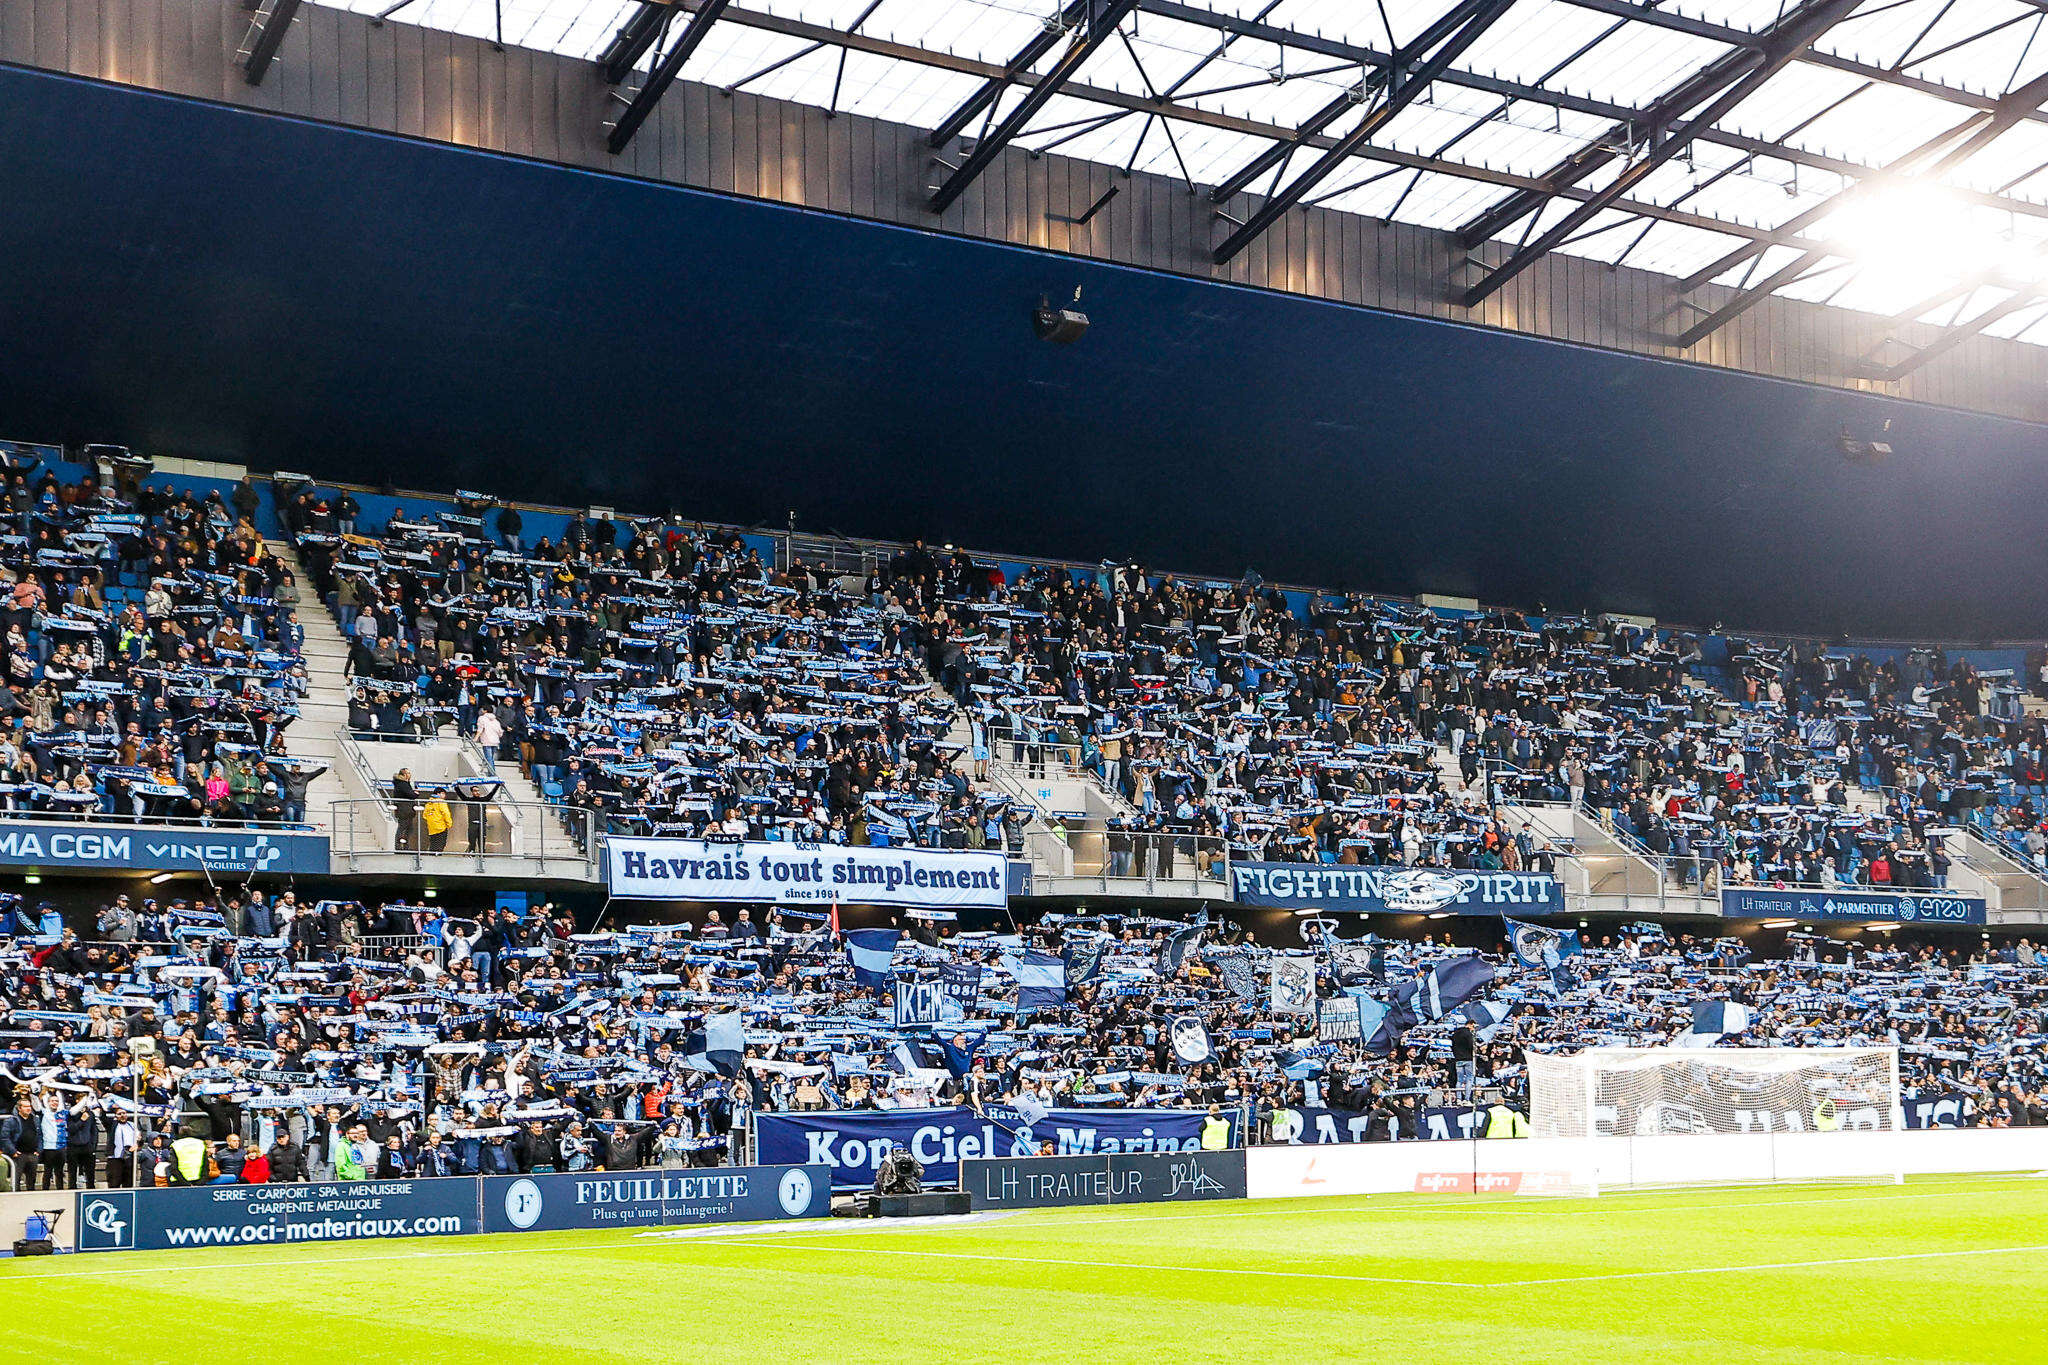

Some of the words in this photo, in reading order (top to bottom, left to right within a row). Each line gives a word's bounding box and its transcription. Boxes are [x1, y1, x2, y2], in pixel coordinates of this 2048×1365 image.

[144, 784, 167, 794] HAC
[50, 834, 130, 861] CGM
[146, 844, 237, 860] VINCI
[622, 851, 750, 880] Havrais
[759, 856, 822, 882] tout
[832, 857, 1000, 891] simplement
[785, 889, 811, 899] since
[1233, 866, 1385, 898] FIGHTIN
[1456, 874, 1553, 903] PIRIT
[1741, 897, 1753, 910] LH
[1754, 900, 1792, 912] TRAITEUR
[1837, 901, 1895, 916] PARMENTIER
[901, 984, 943, 1022] KCM
[514, 1010, 542, 1021] HAC
[988, 1107, 1019, 1120] Havr
[911, 1124, 996, 1164] Ciel
[1056, 1127, 1201, 1155] Marine
[213, 1189, 247, 1202] SERRE
[256, 1187, 309, 1201] CARPORT
[318, 1186, 339, 1198] SPA
[349, 1183, 412, 1197] MENUISERIE
[575, 1175, 749, 1205] FEUILLETTE
[791, 1181, 804, 1201] F
[986, 1167, 1019, 1201] LH
[1026, 1170, 1143, 1199] TRAITEUR
[248, 1201, 315, 1216] CHARPENTE
[317, 1198, 382, 1213] METALLIQUE
[519, 1193, 533, 1213] F
[592, 1207, 617, 1219] Plus
[620, 1207, 659, 1222] qu'une
[662, 1204, 728, 1219] boulangerie
[166, 1214, 461, 1244] www.oci-materiaux.com
